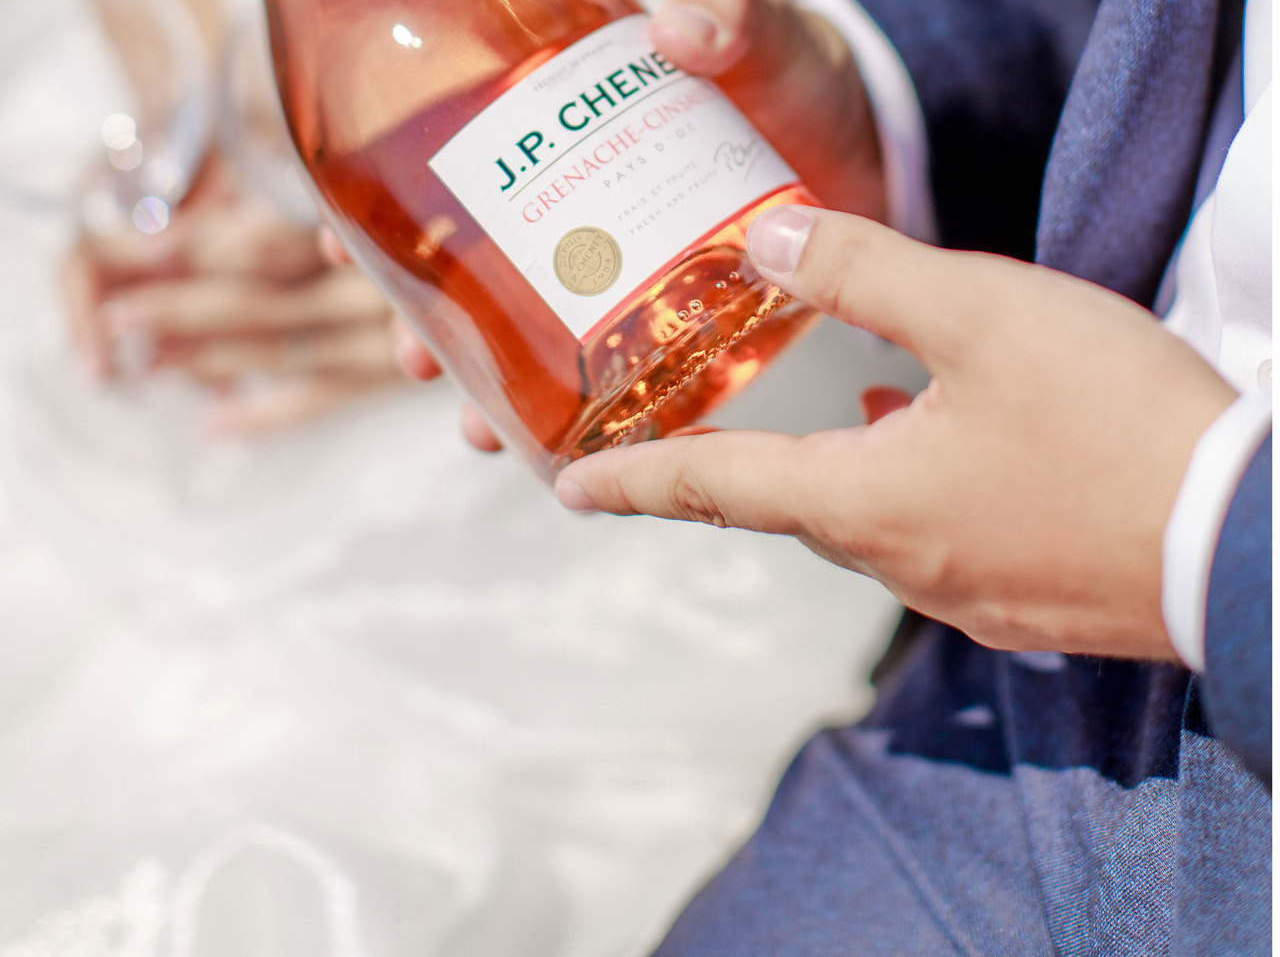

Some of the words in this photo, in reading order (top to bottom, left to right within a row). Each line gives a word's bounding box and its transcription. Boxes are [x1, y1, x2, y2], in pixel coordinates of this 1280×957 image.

[494, 130, 556, 193] J.P.
[557, 50, 682, 132] CHENE
[603, 155, 648, 190] PAYS
[629, 209, 662, 236] FRESH
[666, 192, 686, 209] AND
